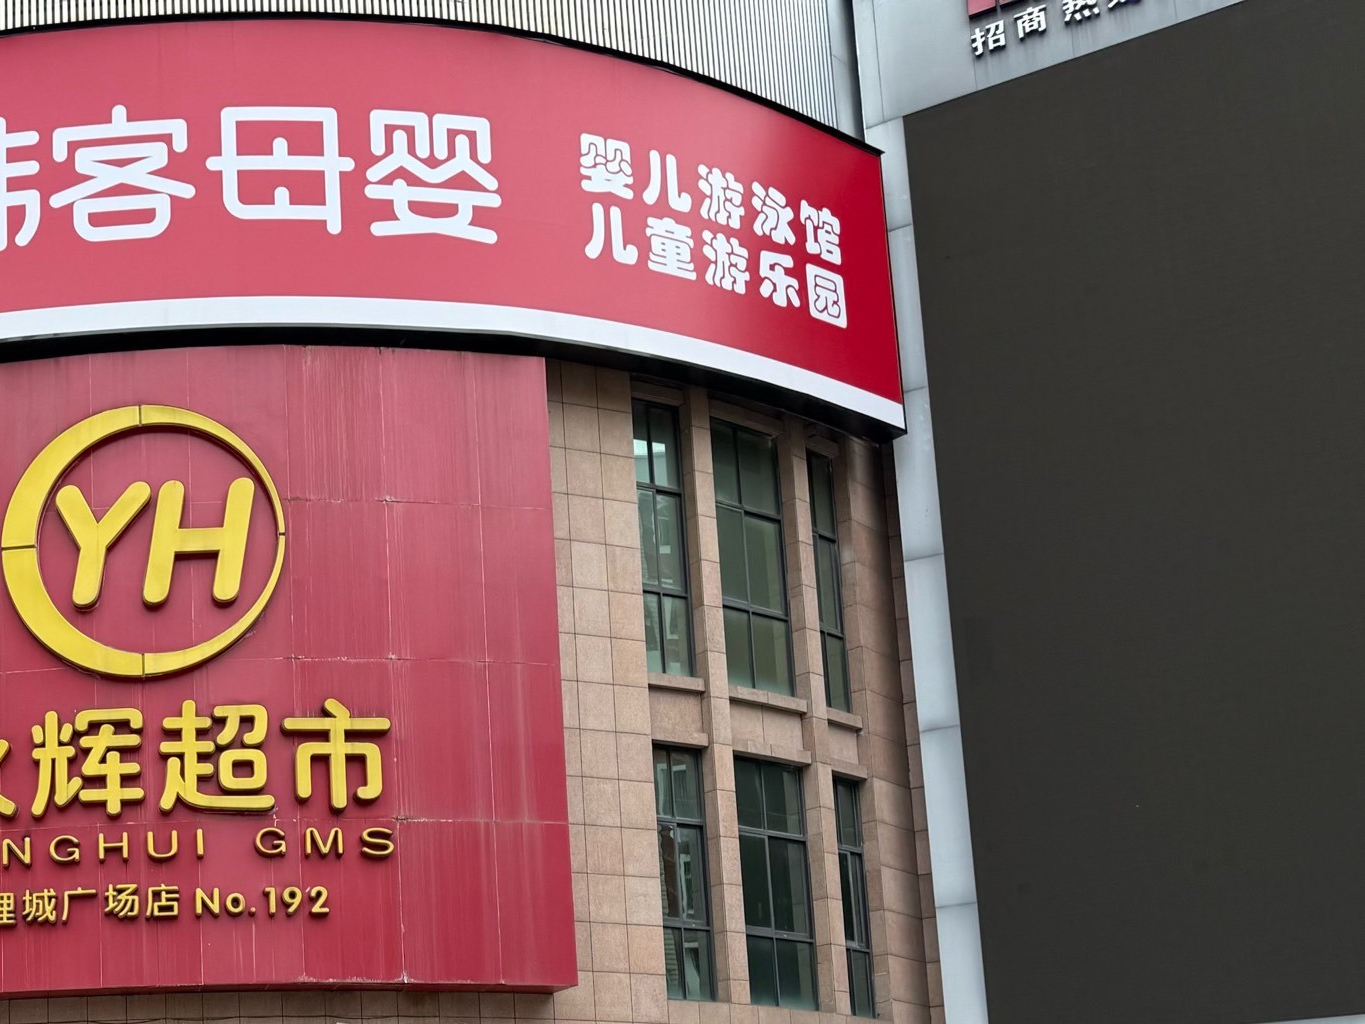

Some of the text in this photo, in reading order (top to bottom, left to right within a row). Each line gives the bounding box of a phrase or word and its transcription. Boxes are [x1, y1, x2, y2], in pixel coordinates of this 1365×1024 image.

[970, 0, 1138, 56] 招商热
[579, 133, 842, 266] 婴儿游泳馆
[585, 203, 848, 329] 儿童游乐园
[54, 477, 255, 610] YH
[255, 827, 395, 858] GMS
[195, 886, 331, 917] No.192
